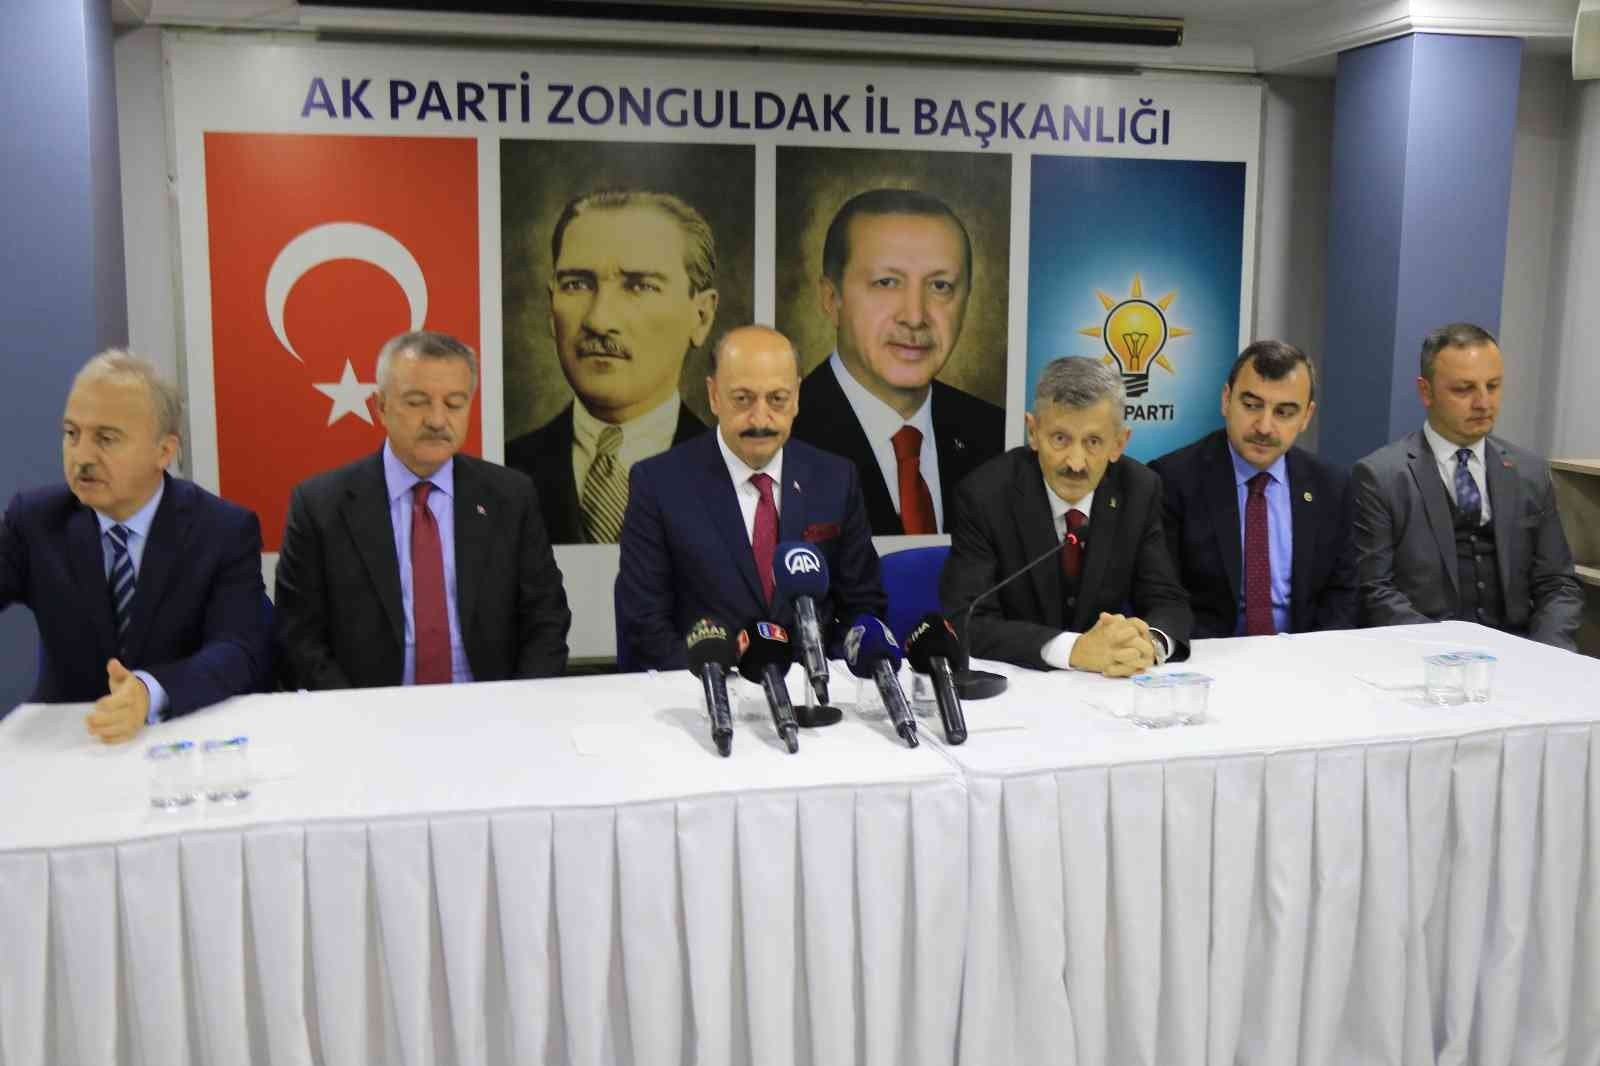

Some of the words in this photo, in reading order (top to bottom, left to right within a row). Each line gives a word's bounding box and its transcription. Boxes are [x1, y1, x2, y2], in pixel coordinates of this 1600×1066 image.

[301, 77, 373, 120] AK
[389, 71, 531, 123] PARTİ
[547, 84, 851, 132] ZONGULDAK
[865, 84, 900, 135] İL
[914, 98, 1171, 148] BAŞKANLIĞI
[787, 551, 820, 575] AA
